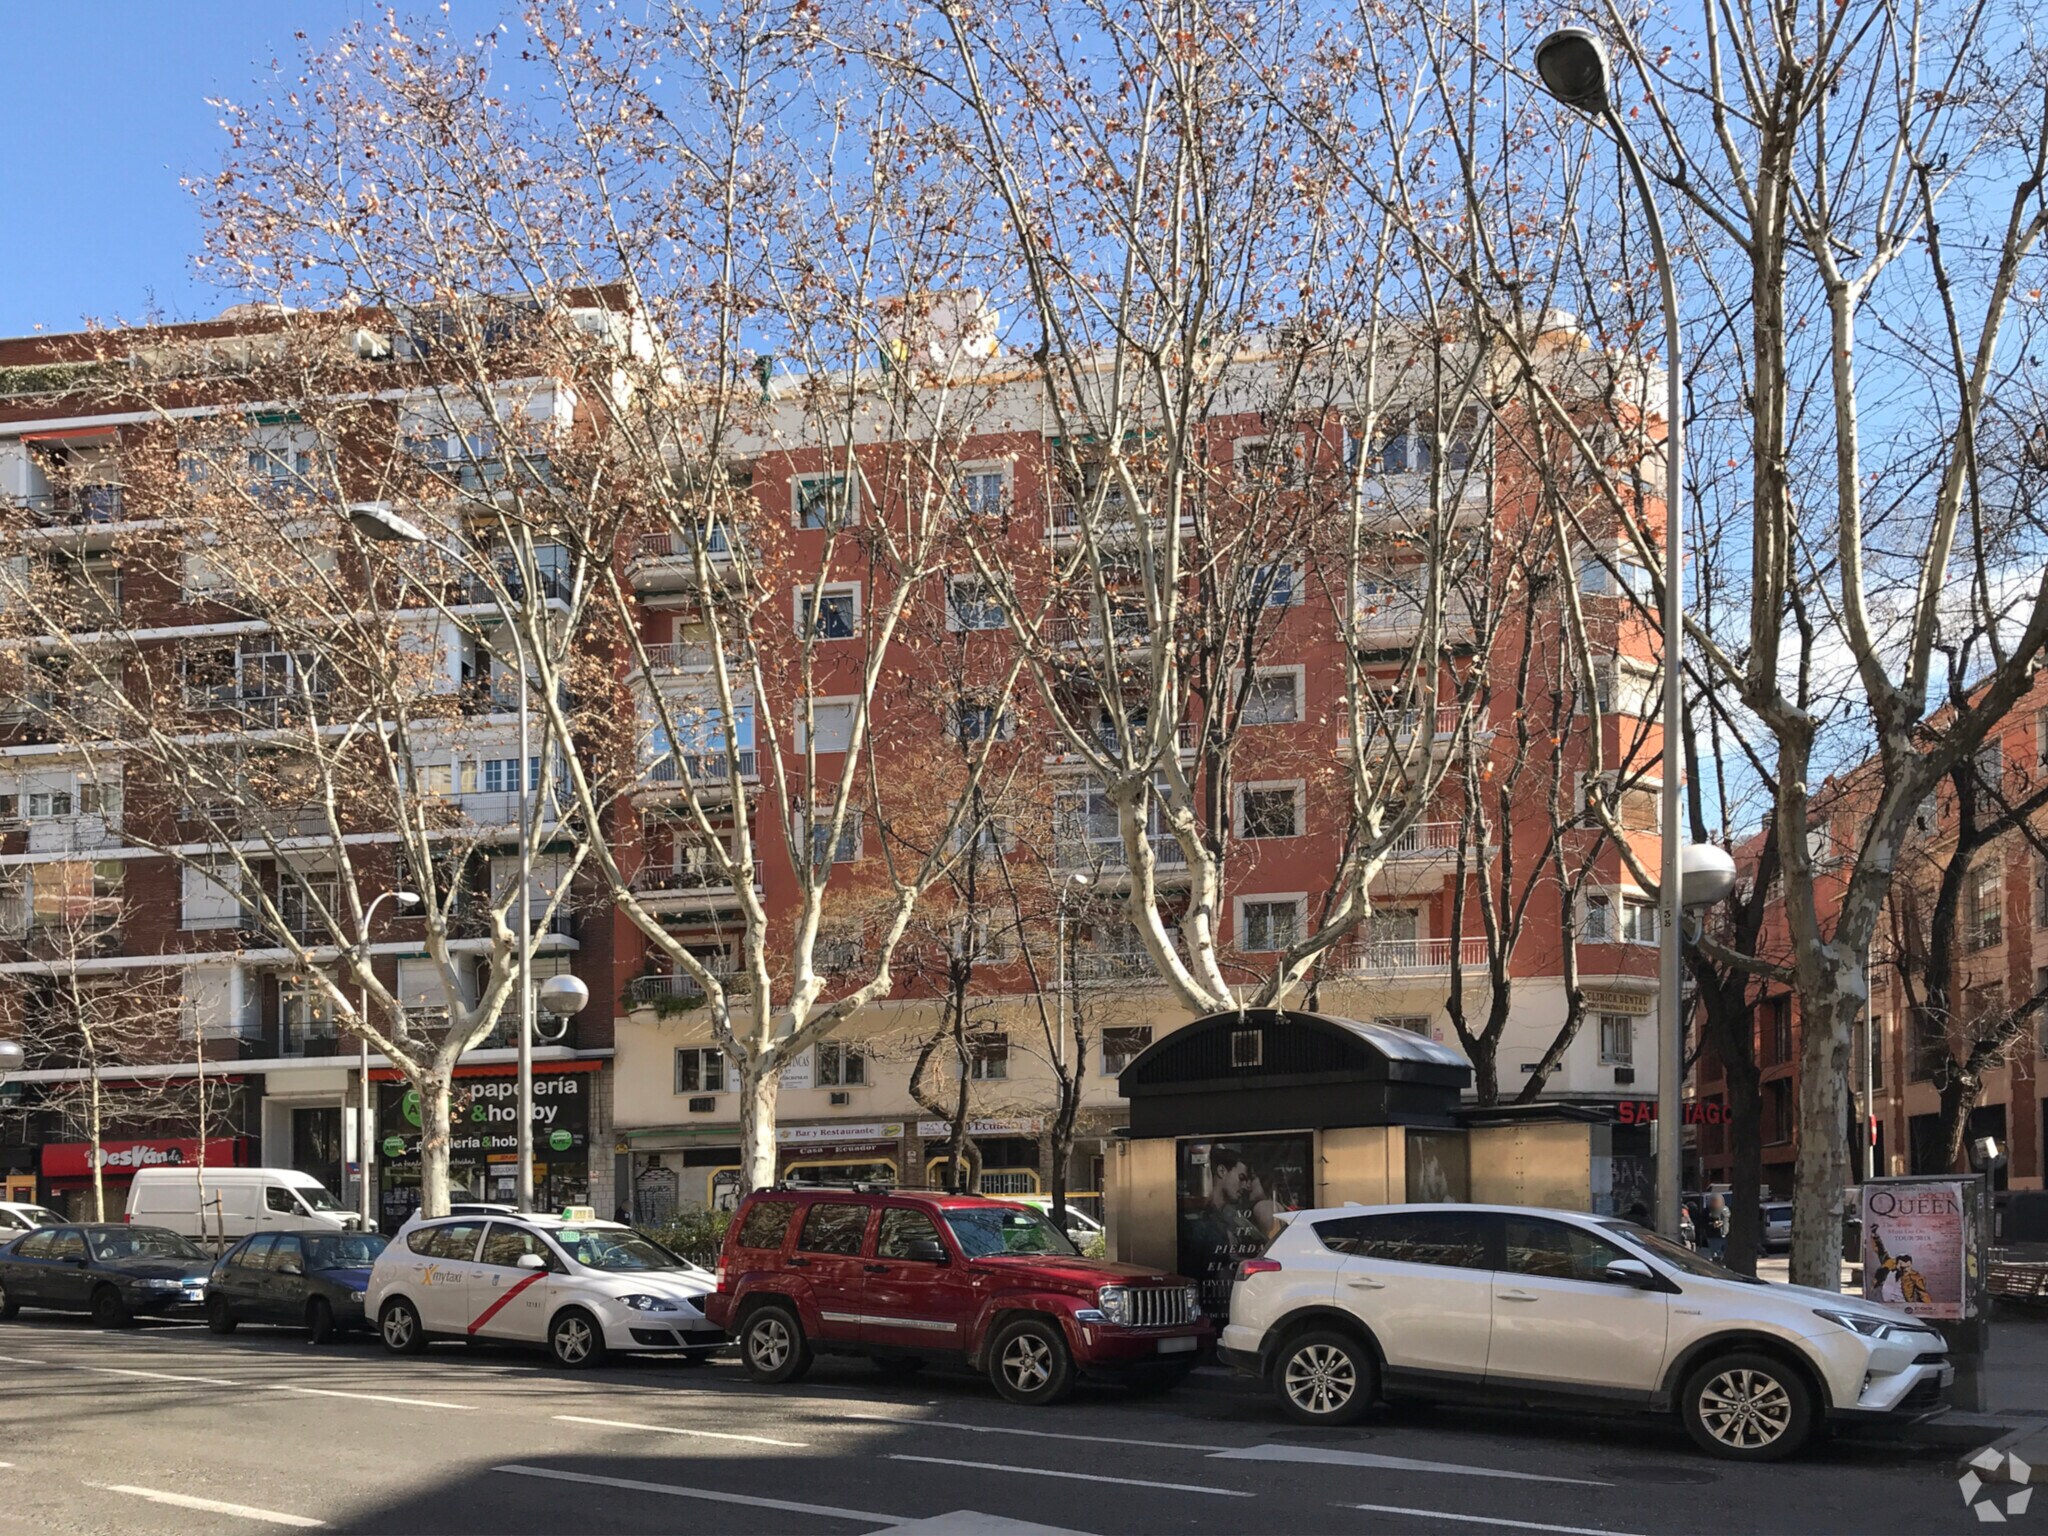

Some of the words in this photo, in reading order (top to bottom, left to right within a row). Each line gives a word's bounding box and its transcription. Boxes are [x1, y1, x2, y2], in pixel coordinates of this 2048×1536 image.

[470, 1076, 578, 1102] papería
[470, 1102, 558, 1124] &hoby
[1618, 1100, 1733, 1125] SAIAGO
[795, 1129, 810, 1137] Bar
[820, 1126, 875, 1137] Restaurante
[799, 1146, 824, 1155] Casa
[835, 1144, 877, 1154] Ecuador
[1869, 1192, 1959, 1218] QUEEN
[1236, 1209, 1252, 1218] NO
[1236, 1226, 1253, 1236] TE
[1214, 1244, 1265, 1254] PIERDA
[1207, 1261, 1224, 1271] EL
[432, 1271, 463, 1285] mytaxi
